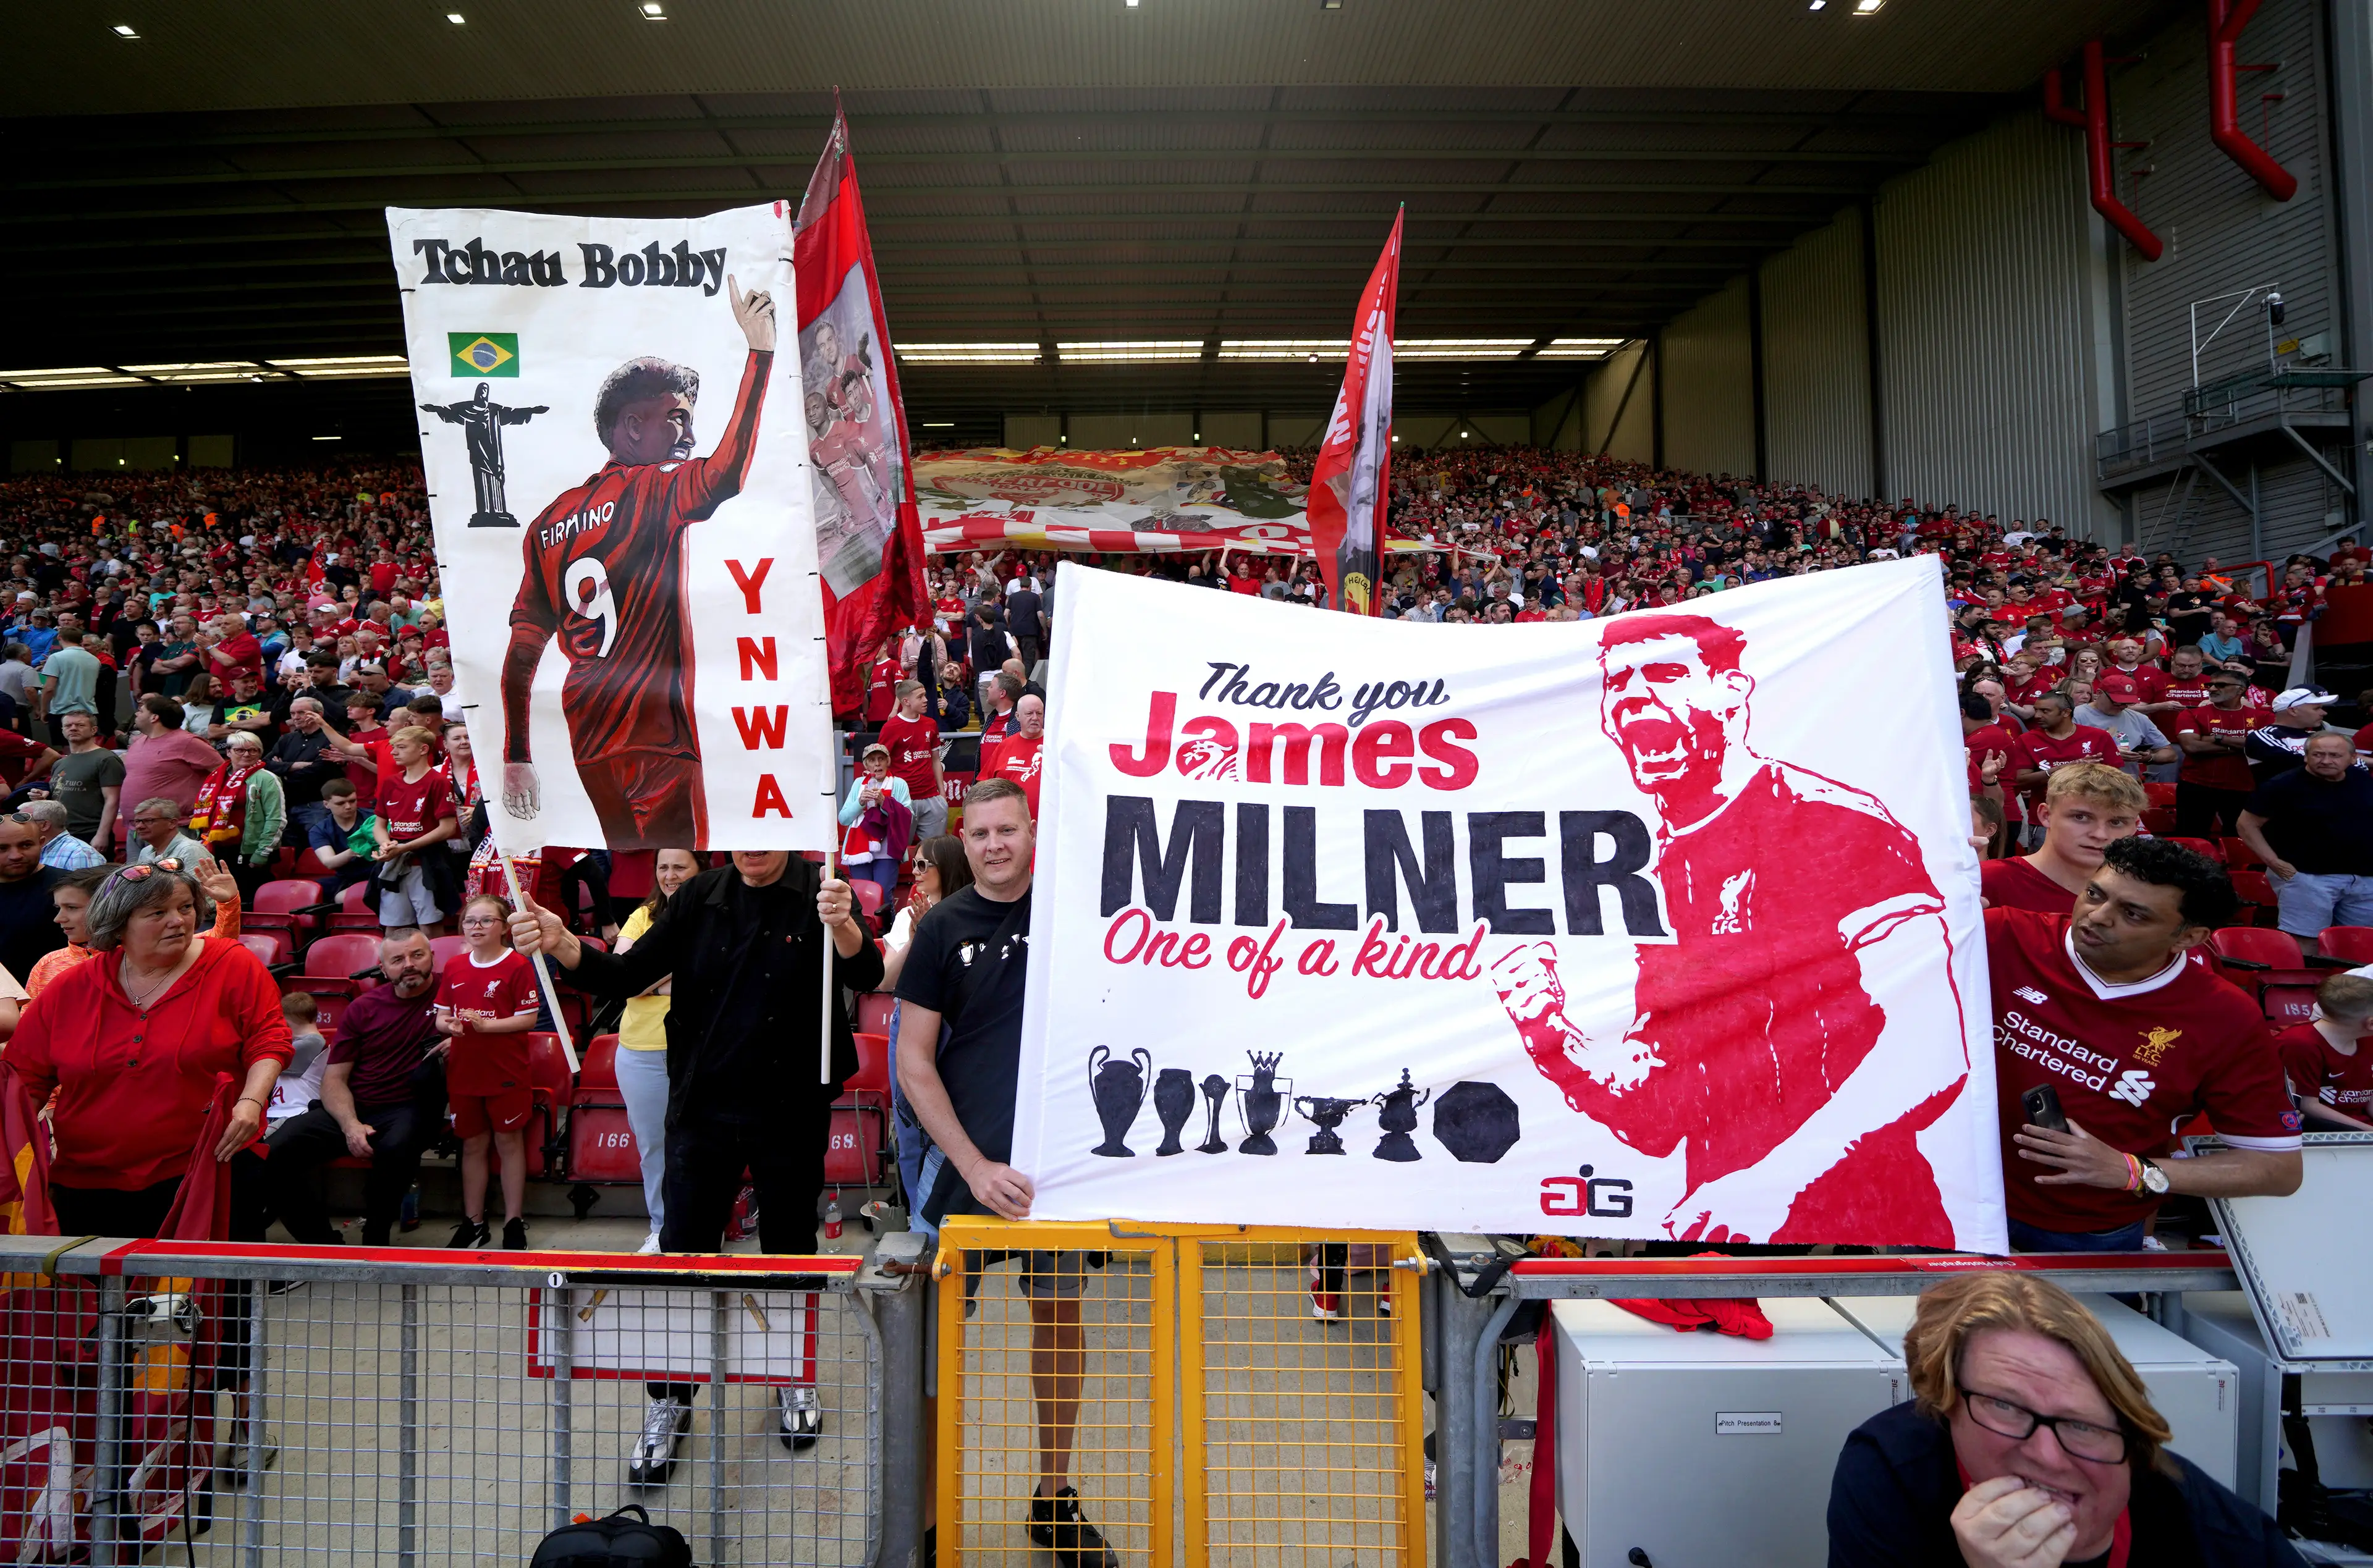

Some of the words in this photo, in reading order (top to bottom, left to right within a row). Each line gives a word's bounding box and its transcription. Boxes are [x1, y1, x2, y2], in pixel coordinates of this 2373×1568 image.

[413, 237, 567, 287] Tchau
[578, 240, 726, 297] Bobby
[541, 500, 615, 550] FIRMINO
[565, 556, 618, 659] 9
[1199, 661, 1343, 710] Thank
[1347, 677, 1451, 728] you
[1108, 691, 1480, 791] James
[1101, 795, 1669, 937] MILNER
[1103, 908, 1211, 970] One
[1227, 918, 1286, 1000] of
[1298, 938, 1339, 976] a
[1351, 913, 1481, 982] kind
[1711, 919, 1742, 935] LFC
[1993, 1024, 2108, 1092] Chartered
[2003, 1011, 2120, 1073] Standard
[2141, 1057, 2159, 1067] YEARS
[598, 1132, 630, 1149] 166
[552, 1274, 557, 1286] 1
